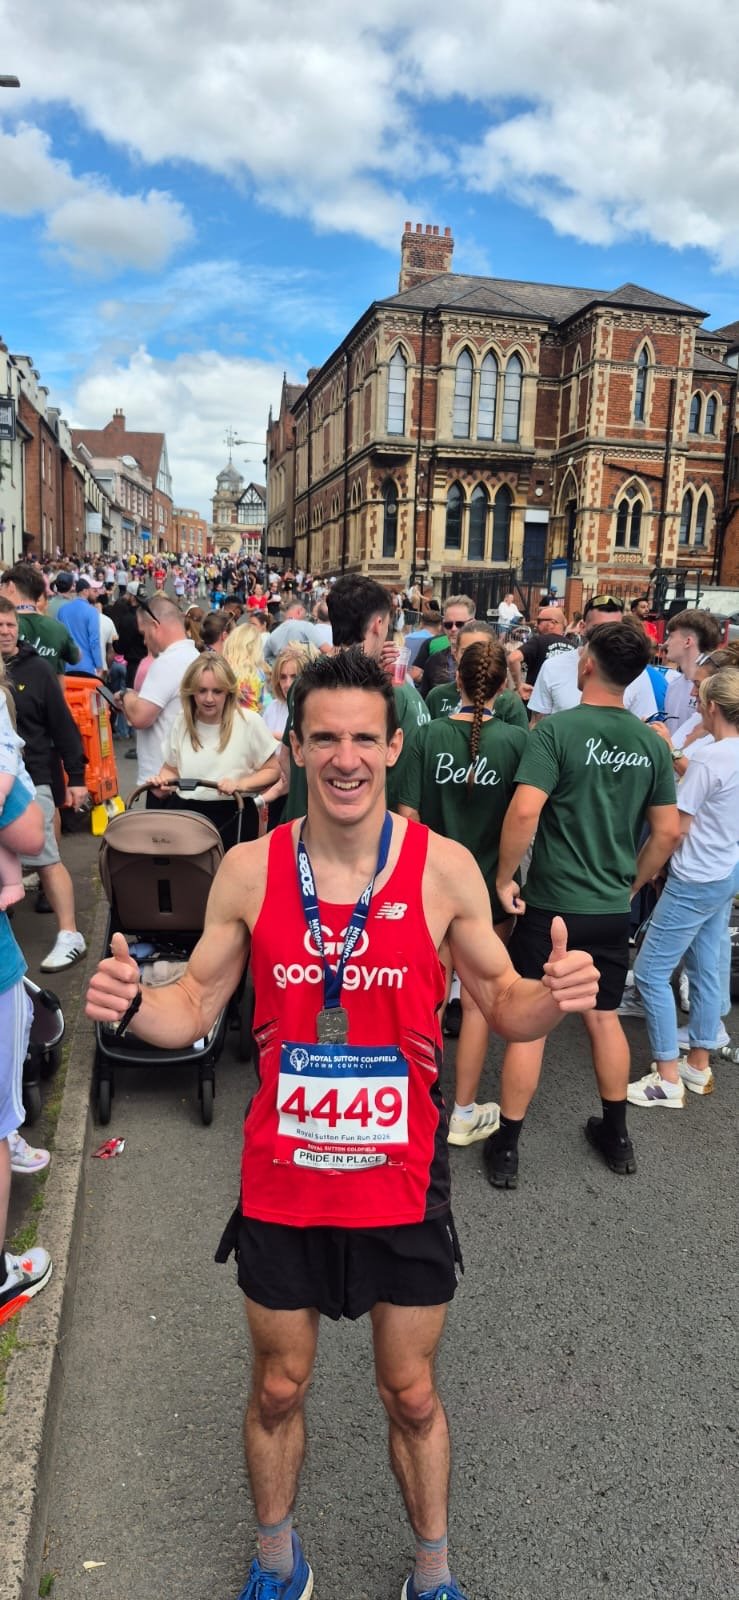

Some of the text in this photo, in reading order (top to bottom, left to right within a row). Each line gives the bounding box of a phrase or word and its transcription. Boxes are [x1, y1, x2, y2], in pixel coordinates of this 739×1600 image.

[585, 737, 652, 773] Keigan
[435, 752, 501, 786] Bella
[298, 852, 315, 896] 2026
[360, 1055, 397, 1063] COLDFIELD
[280, 1086, 402, 1127] 4449
[296, 1128, 313, 1138] Royal
[299, 1151, 382, 1163] PRIDE IN PLACE
[308, 1143, 323, 1151] ROYAL
